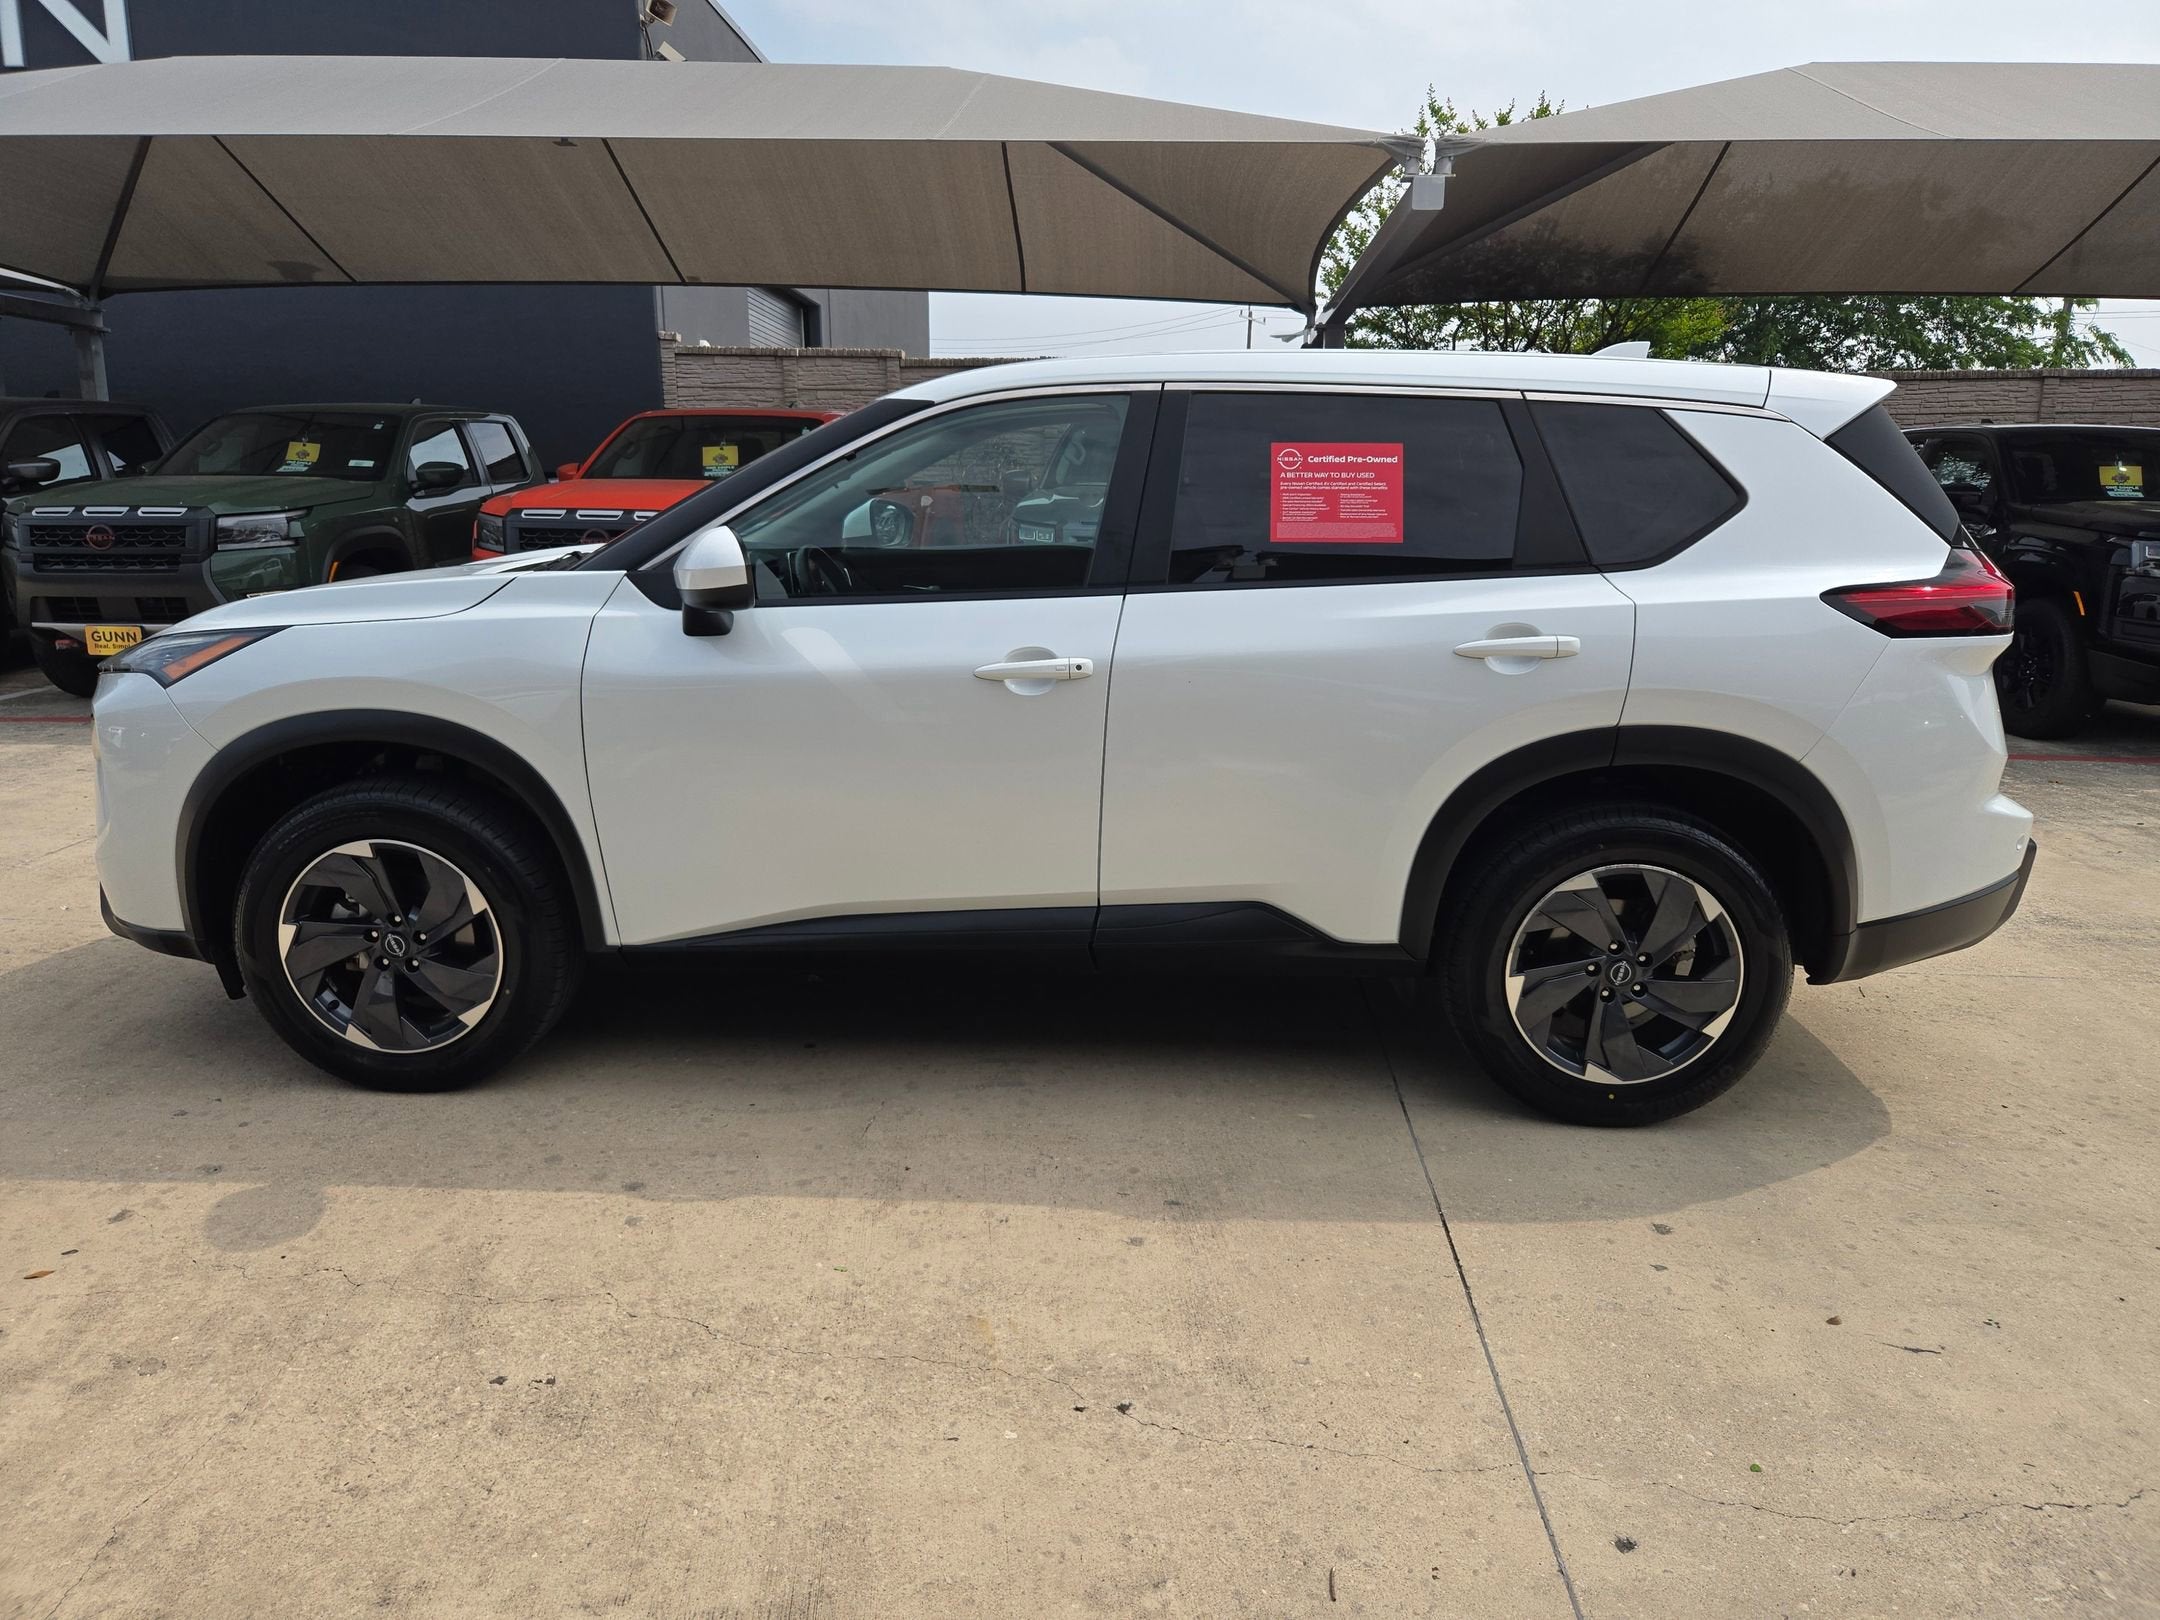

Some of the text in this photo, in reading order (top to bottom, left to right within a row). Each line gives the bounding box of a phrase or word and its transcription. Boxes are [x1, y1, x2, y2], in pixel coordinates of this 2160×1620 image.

[1308, 455, 1398, 463] Certified Pre-Owned
[91, 631, 138, 643] GUNN
